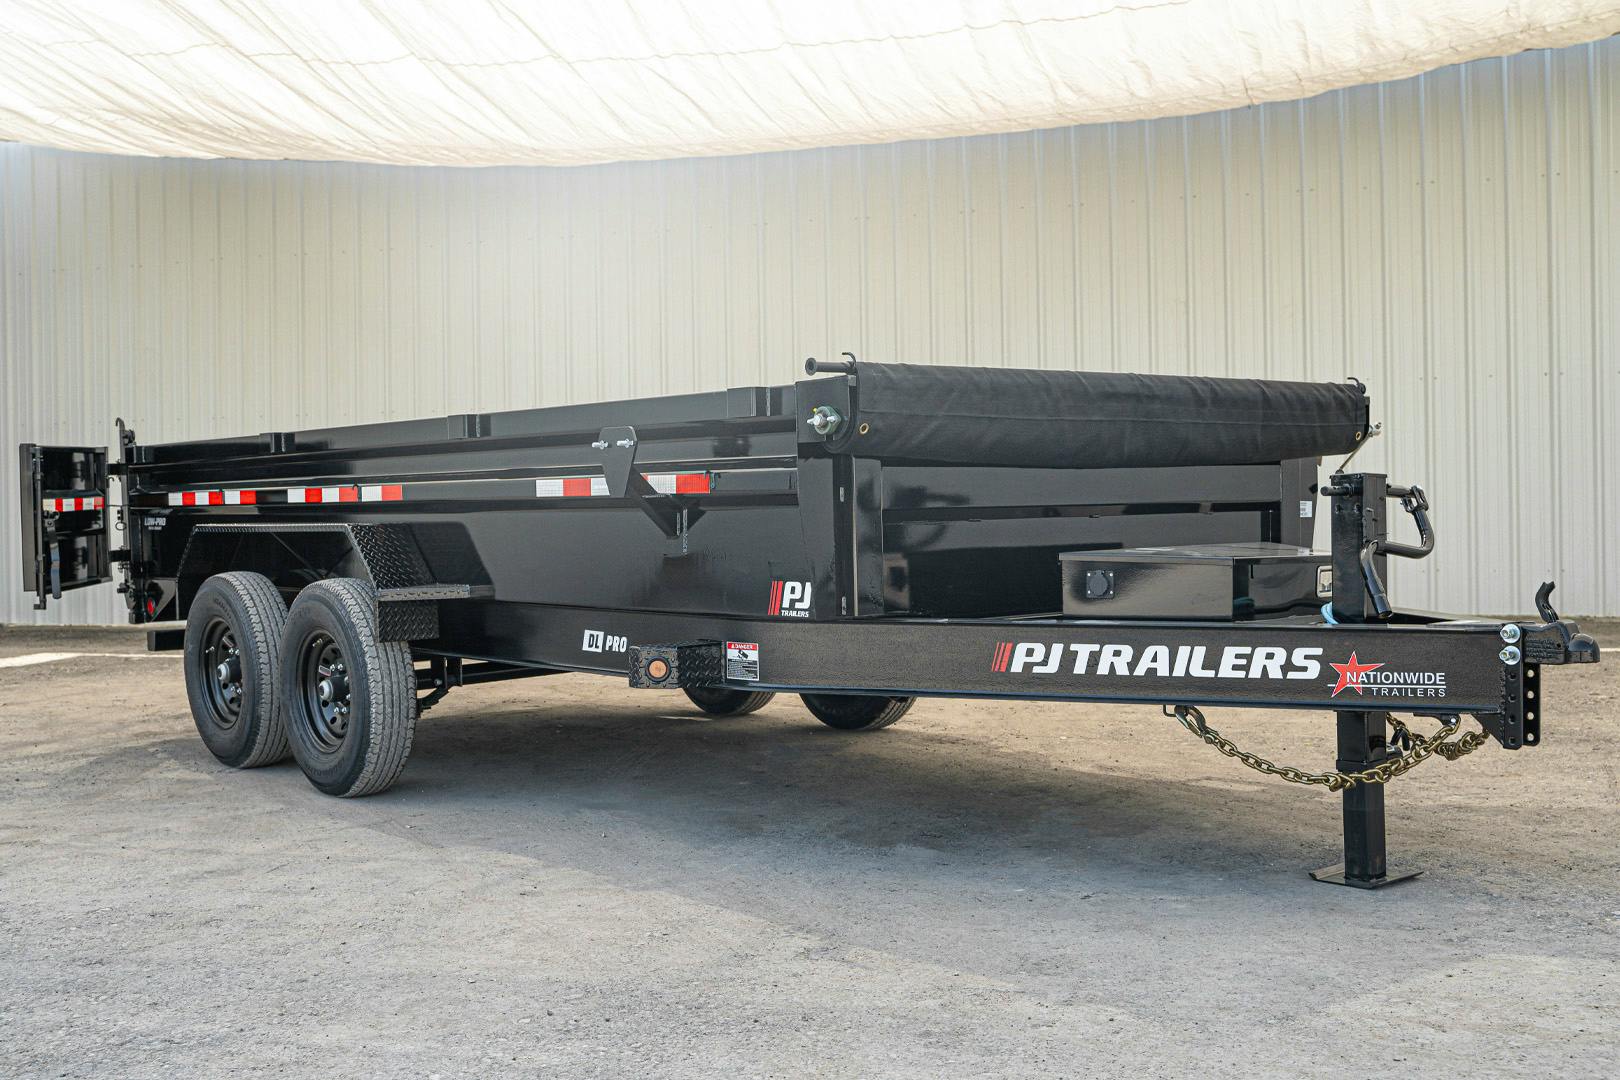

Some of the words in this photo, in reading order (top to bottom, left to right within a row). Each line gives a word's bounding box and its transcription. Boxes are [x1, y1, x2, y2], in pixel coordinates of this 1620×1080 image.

[782, 581, 812, 609] PJ
[781, 610, 809, 618] TRAILERS
[587, 633, 600, 649] DL
[605, 635, 628, 653] PRO
[1010, 642, 1064, 674] PJ
[1069, 644, 1323, 680] TRAILERS
[1346, 671, 1446, 685] NATIONWIDE
[1372, 687, 1446, 698] TRAILERS
